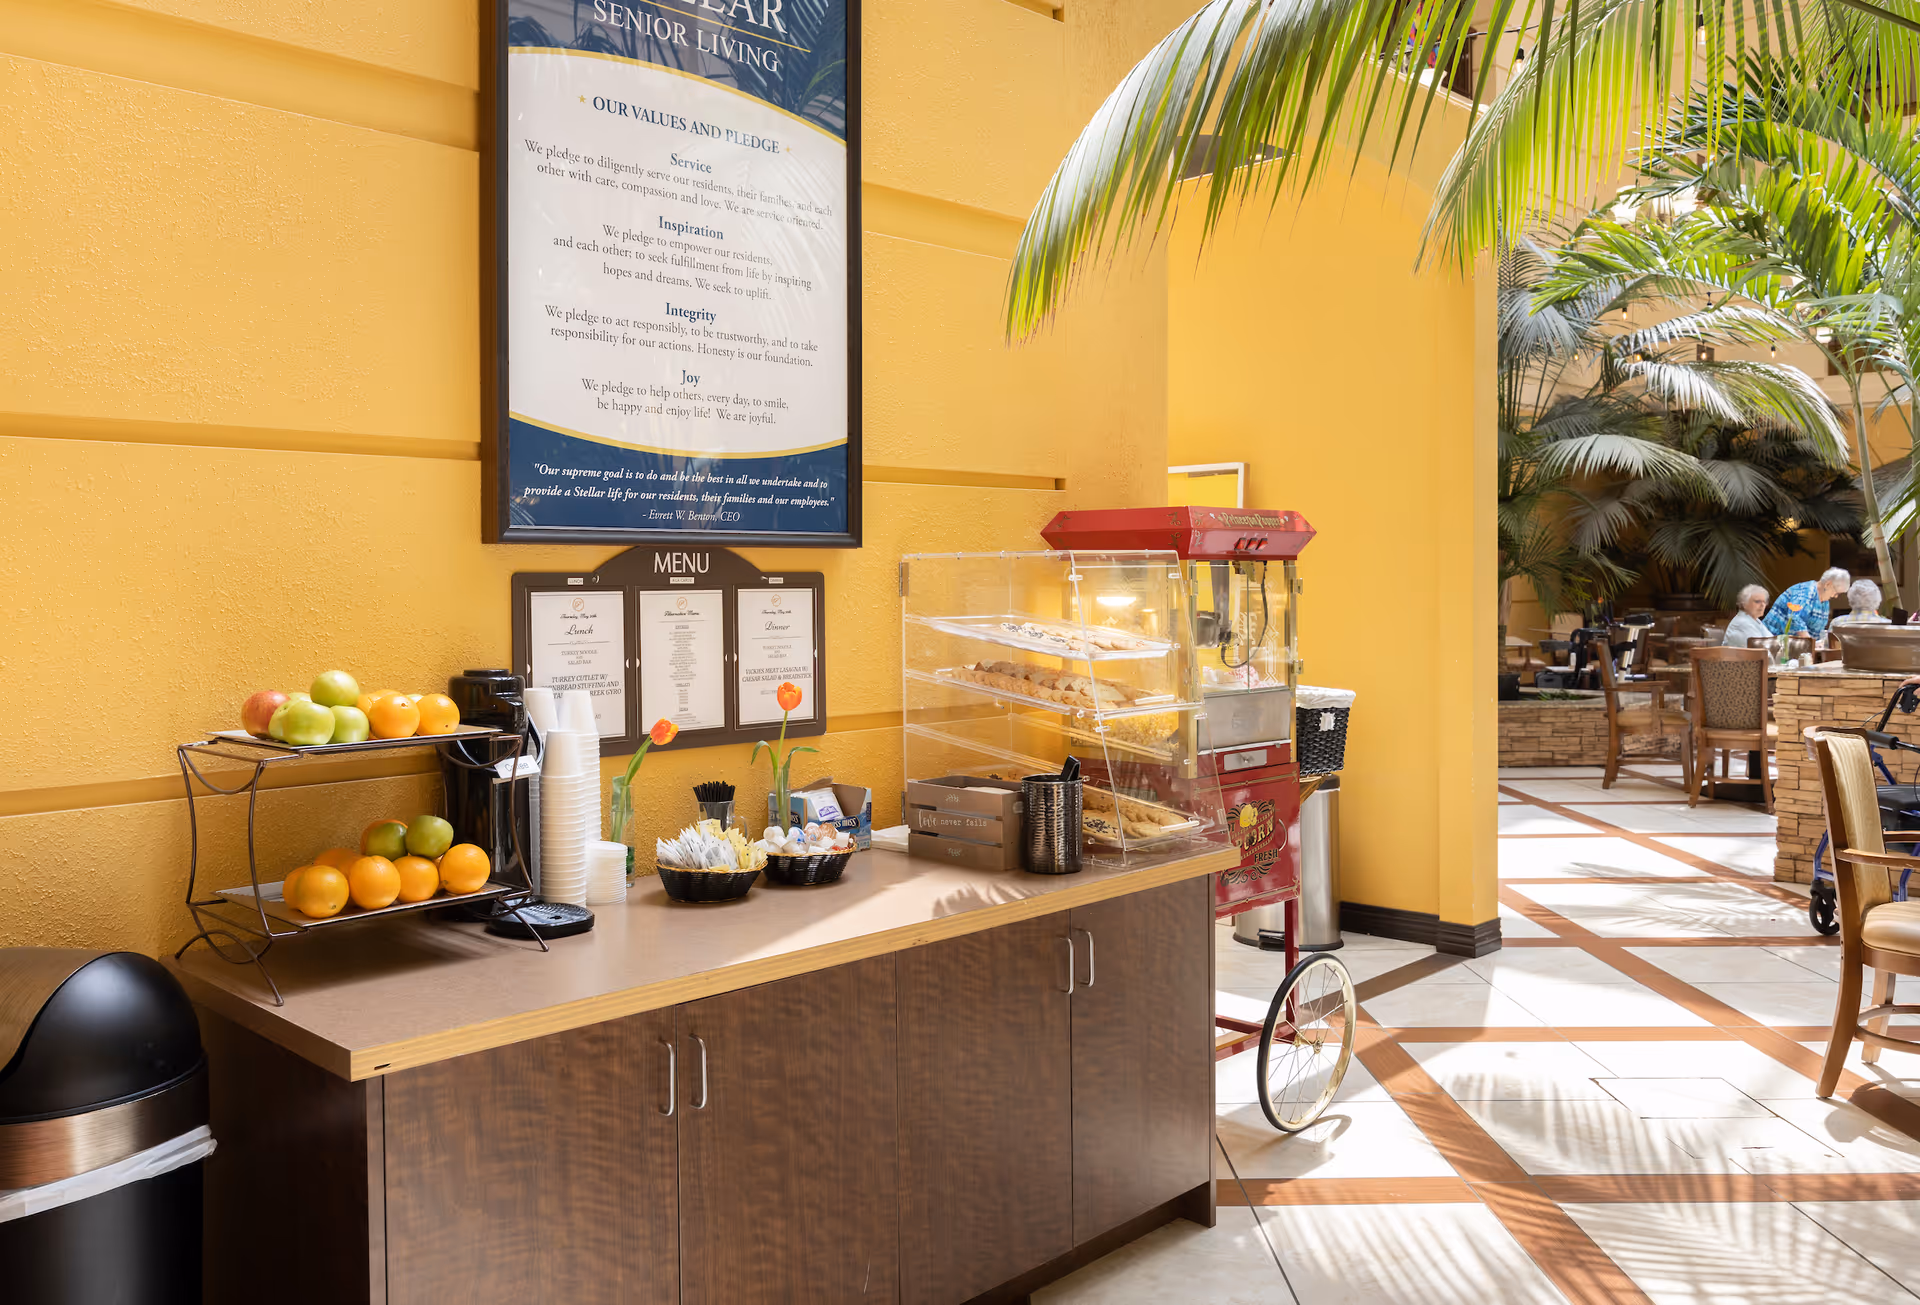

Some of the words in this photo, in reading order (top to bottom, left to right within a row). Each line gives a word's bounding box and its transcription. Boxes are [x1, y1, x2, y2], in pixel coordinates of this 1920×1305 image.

[594, 0, 688, 46] SENIOR
[696, 29, 779, 72] LIVING
[593, 96, 628, 117] OUR
[631, 105, 686, 130] VALUES
[689, 121, 721, 138] AND
[725, 129, 779, 153] PLEDGE
[670, 153, 712, 173] Service
[524, 139, 542, 154] We
[546, 145, 580, 164] pledge
[583, 156, 594, 164] to
[597, 155, 644, 178] diligently
[647, 171, 670, 181] serve
[672, 176, 689, 185] our
[692, 179, 734, 195] residents,
[737, 186, 757, 200] their
[796, 201, 812, 212] and
[814, 205, 832, 216] each
[536, 162, 564, 176] other
[568, 170, 592, 182] with
[595, 177, 618, 188] care,
[621, 182, 678, 200] compassion
[680, 193, 698, 204] and
[700, 194, 721, 208] love.
[724, 199, 739, 212] We
[757, 210, 784, 222] service
[787, 215, 823, 229] oriented.
[659, 215, 723, 239] Inspiration
[602, 224, 619, 238] We
[622, 228, 654, 247] pledge
[657, 237, 667, 246] to
[669, 241, 712, 254] empower
[714, 249, 730, 257] our
[732, 251, 772, 265] residents,
[553, 236, 573, 247] and
[576, 240, 598, 252] each
[602, 243, 632, 258] other;
[635, 251, 645, 259] to
[647, 252, 668, 263] seek
[671, 254, 719, 272] fulfillment
[722, 262, 743, 276] from
[746, 266, 760, 279] life
[761, 269, 773, 284] by
[775, 273, 811, 291] inspiring
[603, 262, 632, 279] hopes
[634, 270, 652, 281] and
[656, 271, 692, 287] dreams.
[695, 277, 710, 290] We
[712, 282, 731, 293] seek
[734, 287, 743, 295] to
[745, 287, 772, 300] uplift.
[666, 302, 716, 325] Integrity
[545, 305, 562, 318] We
[565, 308, 598, 325] pledge
[602, 316, 612, 324] to
[615, 318, 629, 327] act
[633, 320, 688, 337] responsibly,
[703, 326, 713, 338] be
[716, 331, 769, 347] trustworthy,
[771, 337, 787, 347] and
[800, 340, 818, 351] take
[551, 328, 618, 346] responsibility
[622, 332, 635, 345] for
[638, 339, 655, 347] our
[658, 340, 694, 352] actions.
[698, 342, 734, 360] Honesty
[738, 348, 744, 356] is
[746, 350, 762, 360] our
[764, 350, 813, 366] foundation.
[680, 370, 700, 387] Joy
[581, 378, 598, 391] We
[601, 380, 634, 397] pledge
[650, 384, 670, 401] help
[672, 388, 704, 401] others,
[706, 395, 730, 406] every
[732, 393, 750, 408] day,
[764, 397, 788, 409] smile,
[597, 397, 608, 409] be
[612, 398, 642, 414] happy
[644, 403, 662, 414] and
[665, 405, 691, 419] enjoy
[694, 406, 710, 418] life!
[716, 408, 731, 420] We
[749, 412, 776, 425] joyful.
[534, 463, 560, 475] "Our
[561, 468, 602, 479] supreme
[602, 468, 624, 481] goal
[625, 469, 633, 478] is
[634, 471, 644, 479] to
[646, 469, 658, 480] do
[659, 470, 678, 481] and
[679, 470, 692, 481] be
[691, 471, 706, 482] the
[706, 472, 724, 483] best
[725, 474, 734, 483] in
[735, 474, 748, 484] all
[761, 476, 802, 487] undertake
[802, 478, 819, 488] and
[524, 484, 562, 502] provide
[573, 486, 606, 497] Stellar
[606, 487, 623, 501] life
[622, 487, 639, 501] for
[658, 490, 699, 502] residents,
[701, 491, 720, 504] their
[720, 492, 756, 507] families
[756, 494, 774, 504] and
[790, 495, 835, 508] employees."
[675, 510, 686, 520] W.
[688, 510, 718, 520] Benton,
[720, 510, 740, 521] CEO
[654, 552, 710, 573] MENU
[564, 624, 594, 635] Lunch
[765, 621, 790, 631] Dinner
[1254, 848, 1278, 862] FRESH
